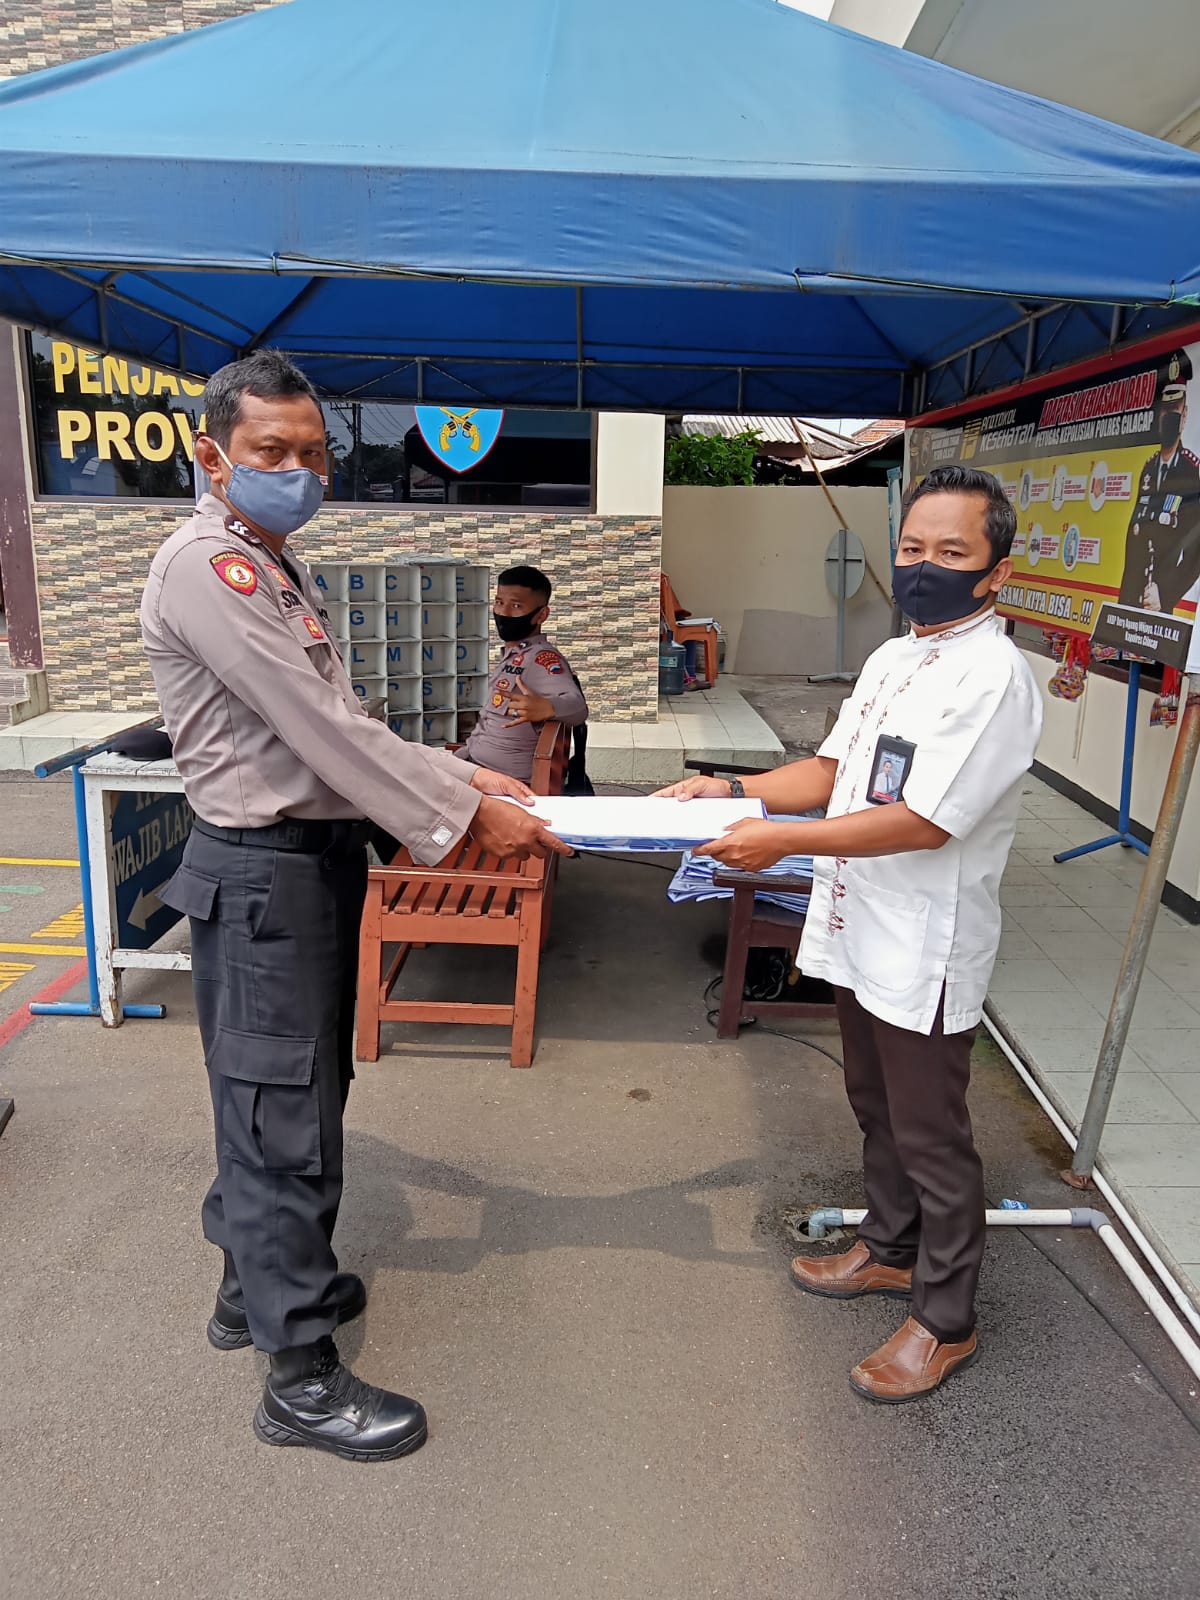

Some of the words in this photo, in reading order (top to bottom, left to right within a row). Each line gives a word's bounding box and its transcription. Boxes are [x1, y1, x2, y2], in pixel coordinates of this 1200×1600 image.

[1124, 370, 1157, 412] BARU
[1060, 420, 1096, 442] KEPOLISIAN
[1095, 416, 1121, 438] POLRES
[1121, 410, 1154, 435] CILACAP
[315, 575, 328, 590] A
[350, 574, 364, 590] B
[385, 575, 397, 590] C
[421, 576, 432, 590] D
[1024, 588, 1047, 614] KITA
[1047, 592, 1072, 620] BISA
[350, 610, 365, 626] G
[386, 610, 398, 625] H
[424, 610, 428, 624] I
[456, 611, 463, 627] J
[353, 648, 365, 662] L
[386, 647, 400, 662] M
[422, 646, 433, 661] N
[423, 681, 432, 695] S
[424, 719, 434, 732] Y
[113, 818, 161, 887] WAJIB
